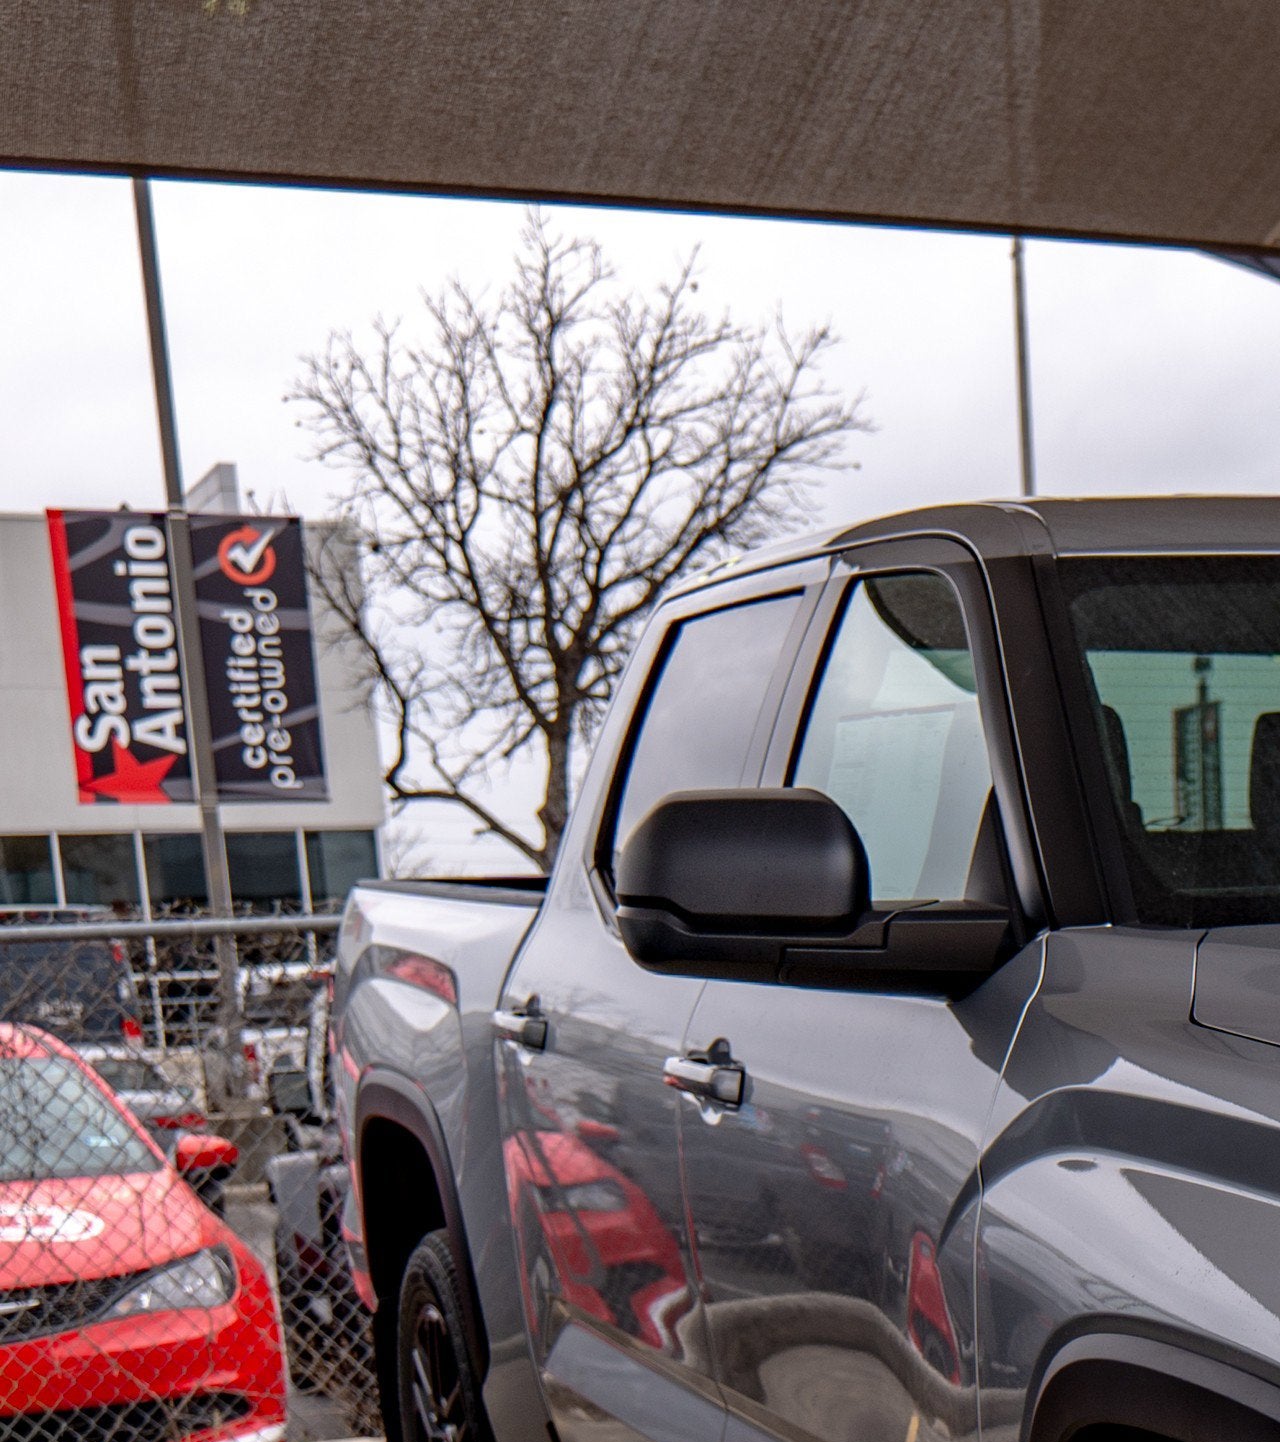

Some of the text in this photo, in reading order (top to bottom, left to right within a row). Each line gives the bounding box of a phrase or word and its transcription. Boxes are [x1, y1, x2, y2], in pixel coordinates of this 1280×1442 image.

[74, 644, 131, 752] San
[113, 526, 187, 754] Antonio
[220, 609, 268, 769] certified
[244, 588, 304, 790] pre-owned
